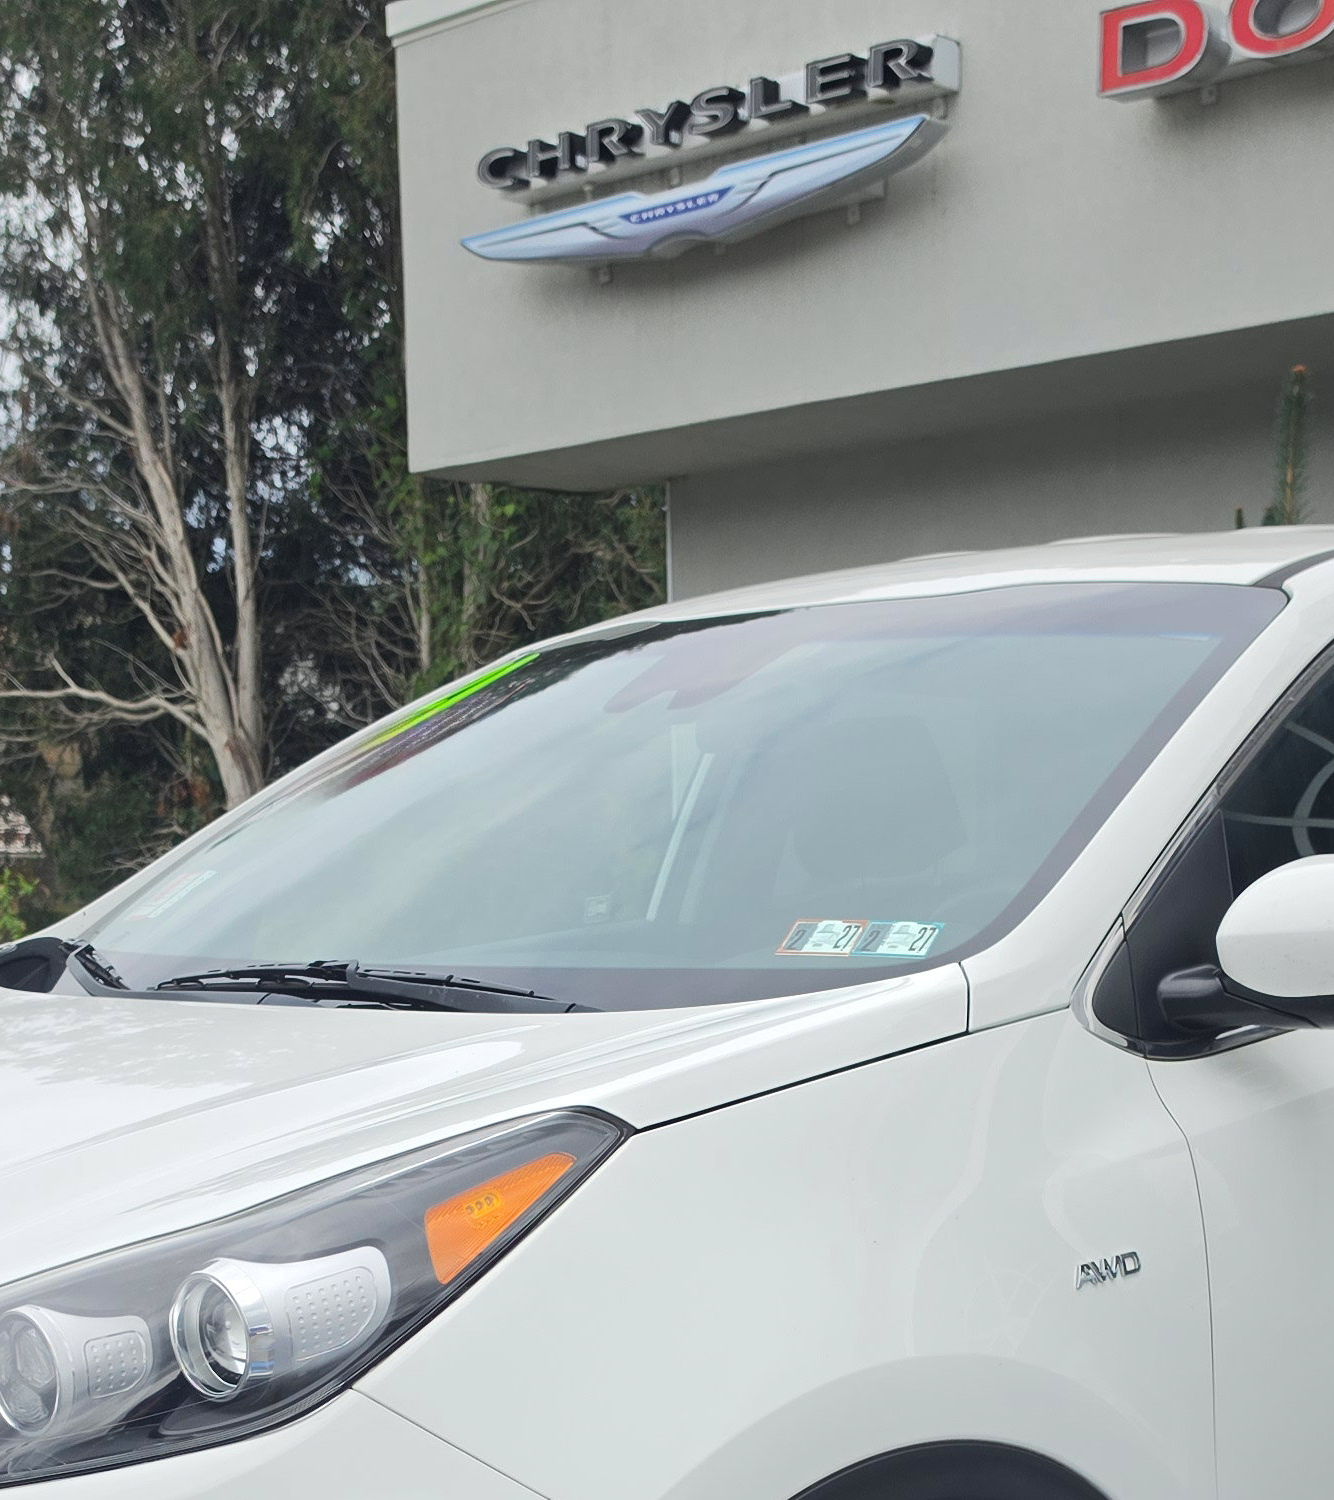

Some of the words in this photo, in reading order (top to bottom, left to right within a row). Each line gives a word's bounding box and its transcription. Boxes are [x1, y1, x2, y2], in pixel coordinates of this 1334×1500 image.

[476, 38, 931, 190] CHRYSLER
[629, 192, 721, 223] CHRYSLER
[833, 925, 860, 951] 27
[909, 927, 936, 953] 27
[1075, 1251, 1141, 1290] AWD
